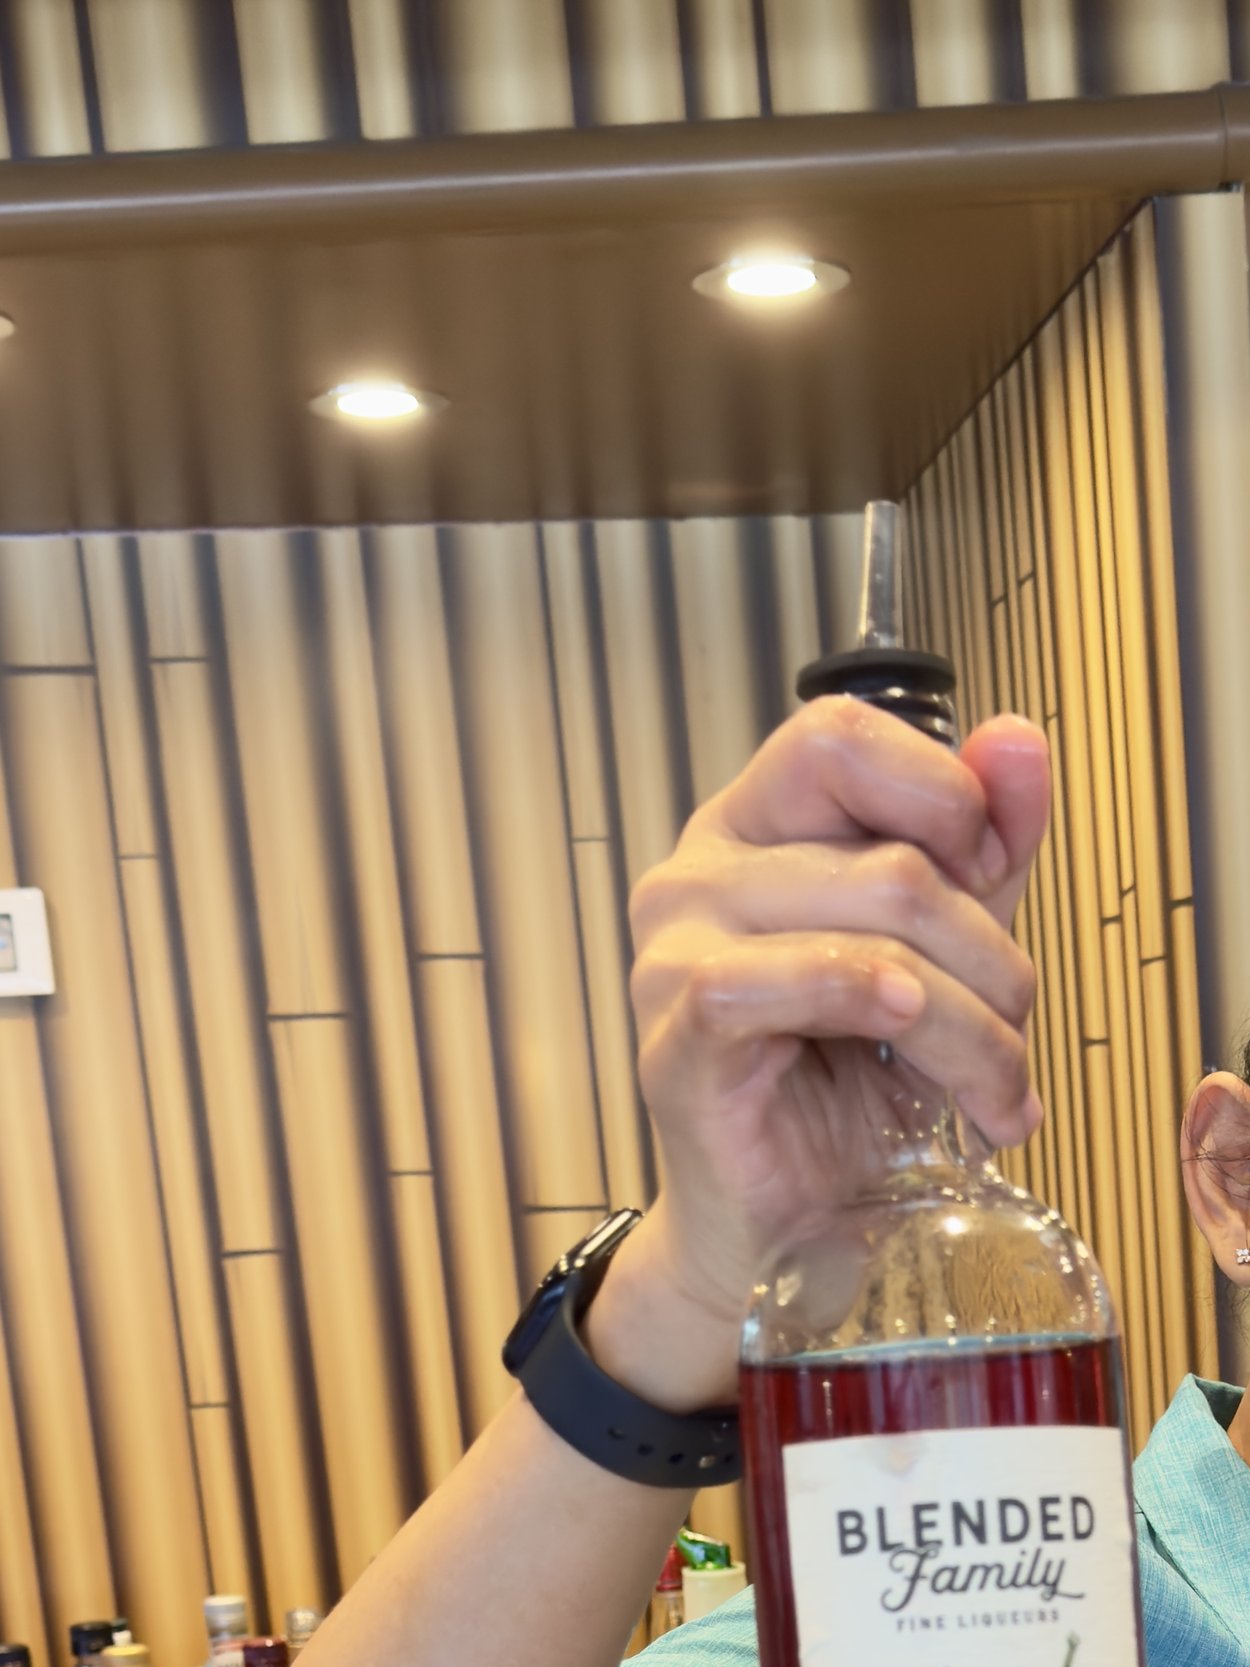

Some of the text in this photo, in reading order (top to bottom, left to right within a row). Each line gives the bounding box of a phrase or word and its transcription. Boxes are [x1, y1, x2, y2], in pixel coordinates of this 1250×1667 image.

[837, 1495, 1095, 1557] BLENDED
[880, 1541, 1086, 1613] Family
[896, 1608, 1061, 1633] FINE LIQUEURS
